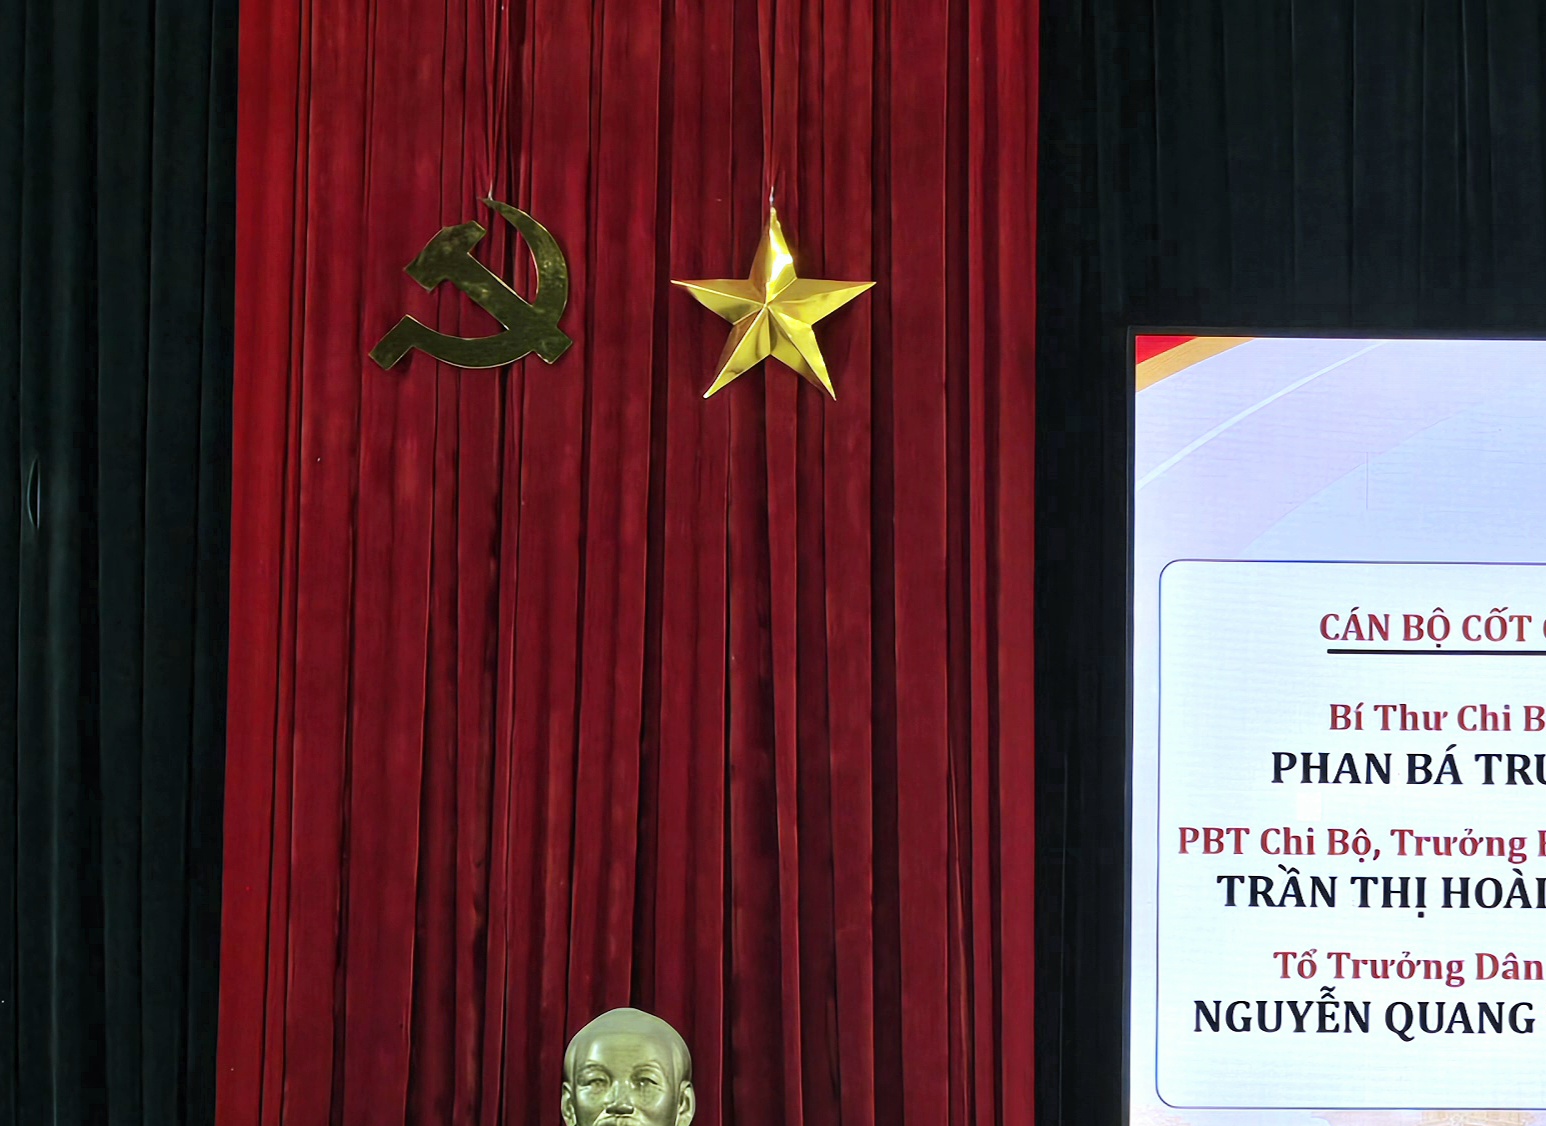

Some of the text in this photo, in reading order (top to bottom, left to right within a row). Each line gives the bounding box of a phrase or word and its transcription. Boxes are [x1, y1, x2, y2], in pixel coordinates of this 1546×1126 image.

[1319, 606, 1390, 642] CÁN
[1402, 606, 1451, 648] BỘ
[1462, 607, 1532, 642] CỐT
[1328, 702, 1364, 731] Bí
[1373, 703, 1449, 731] Thư
[1457, 703, 1512, 732] Chi
[1271, 751, 1392, 785] PHAN
[1406, 743, 1464, 785] BÁ
[1178, 827, 1250, 855] PBT
[1260, 827, 1316, 856] Chi
[1327, 827, 1381, 863] Bộ,
[1390, 828, 1528, 865] Trưởng
[1216, 864, 1338, 908] TRẦN
[1350, 876, 1428, 919] THỊ
[1273, 948, 1317, 981] Tổ
[1327, 951, 1466, 989] Trưởng
[1475, 952, 1544, 981] Dân
[1193, 985, 1372, 1034] NGUYỄN
[1384, 1000, 1536, 1043] QUANG
